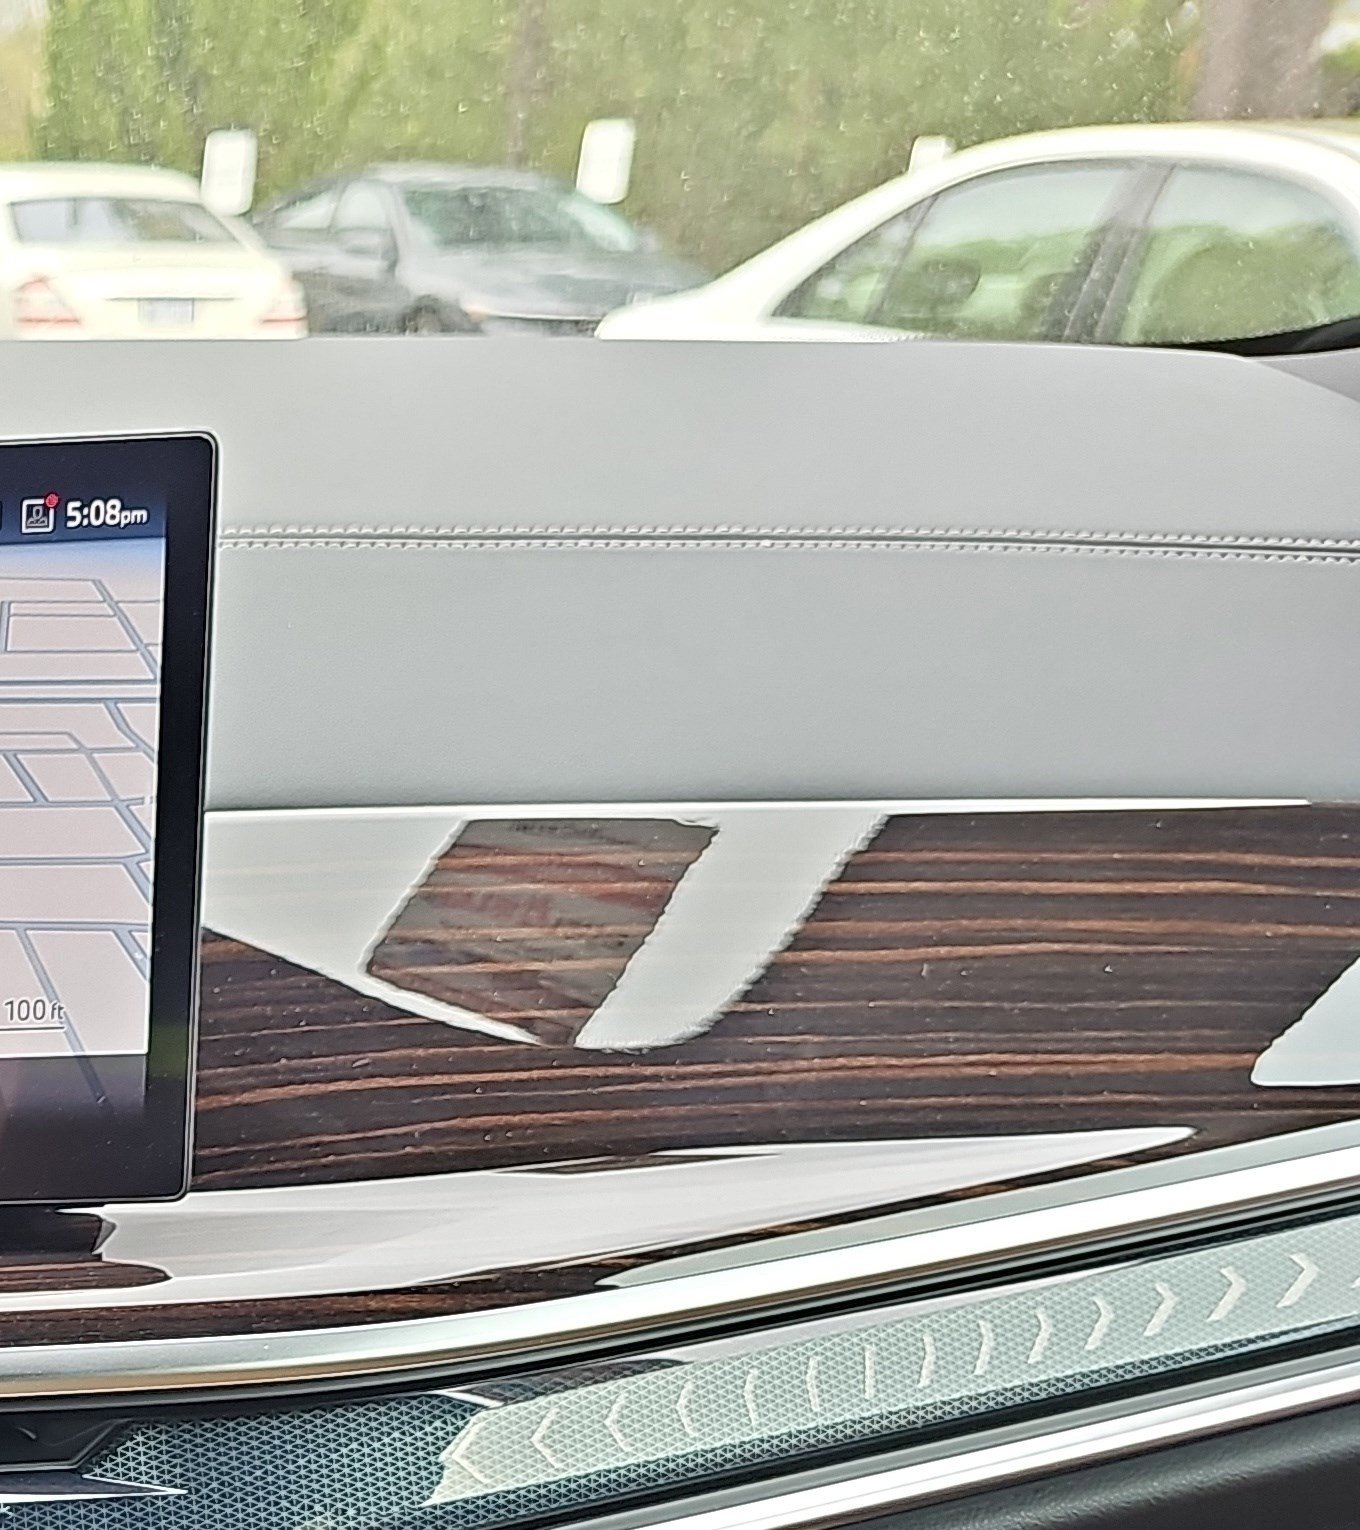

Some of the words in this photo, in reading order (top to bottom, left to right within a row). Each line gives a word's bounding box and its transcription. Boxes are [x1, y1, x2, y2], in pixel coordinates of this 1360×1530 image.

[66, 499, 149, 528] 5:08pm
[4, 999, 47, 1021] 100
[49, 1002, 66, 1021] ft
